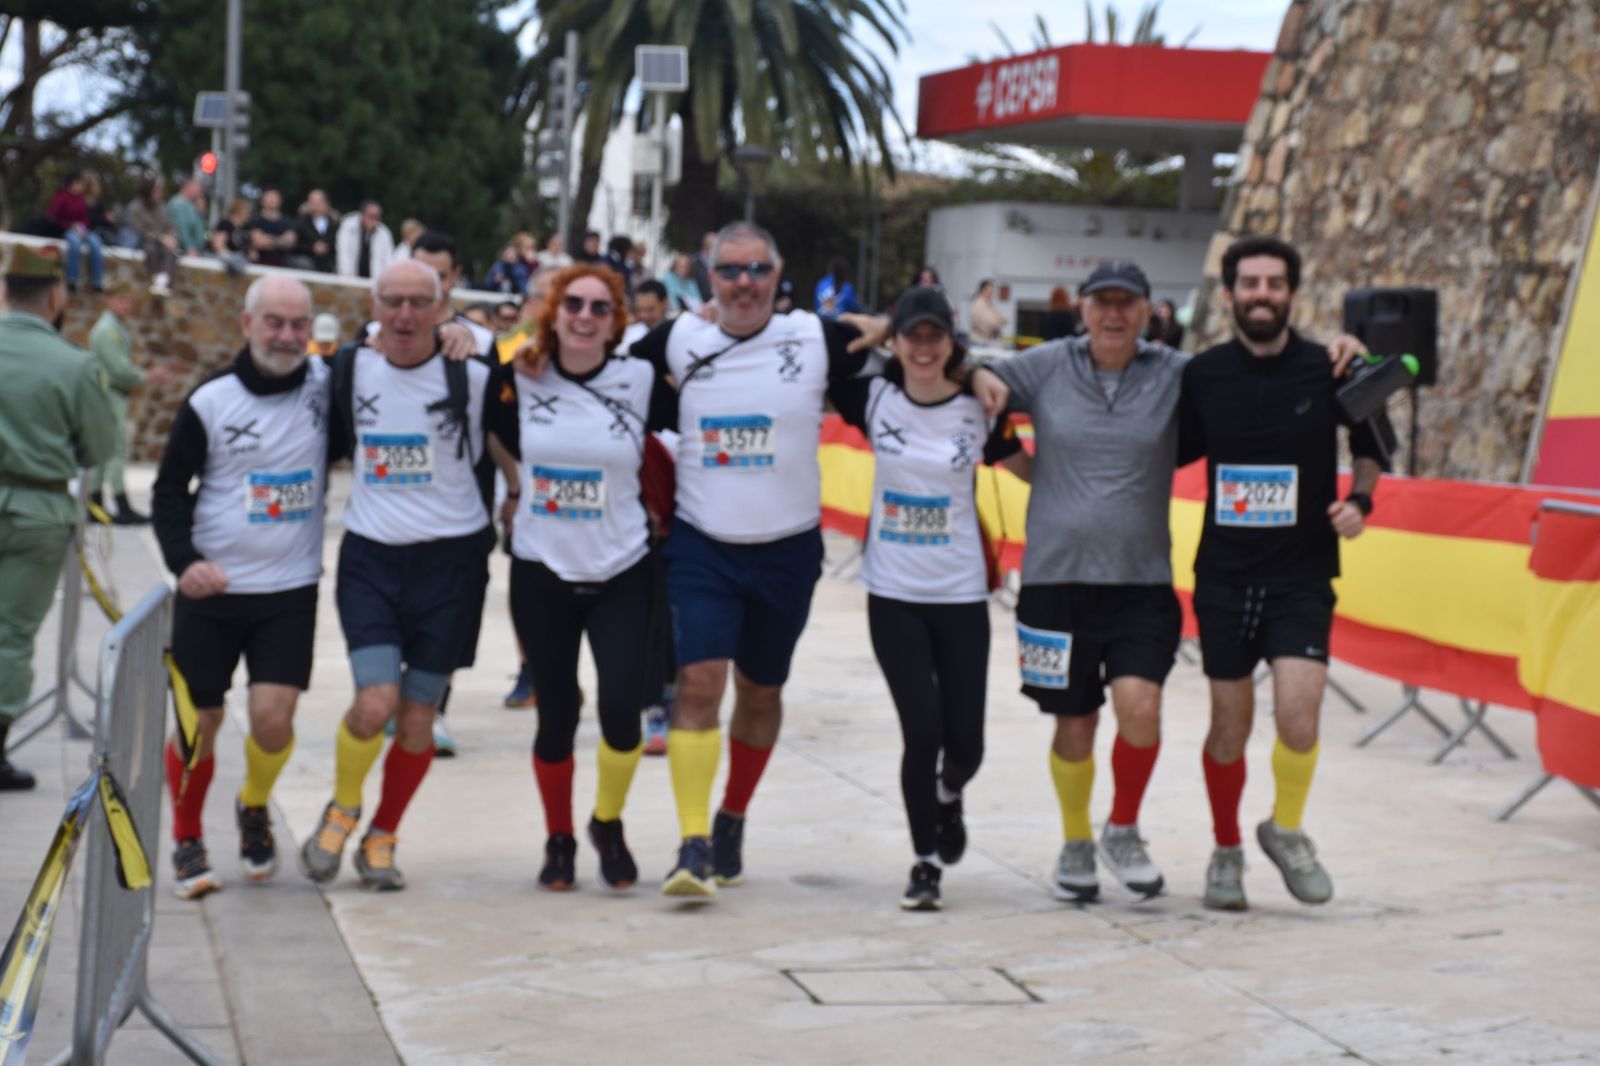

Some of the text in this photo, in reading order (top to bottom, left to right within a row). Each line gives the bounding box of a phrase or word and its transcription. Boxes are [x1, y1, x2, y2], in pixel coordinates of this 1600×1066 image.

[994, 55, 1060, 119] CEPSA
[723, 426, 770, 451] 3577
[554, 479, 600, 504] 2043
[1242, 482, 1291, 506] 2027
